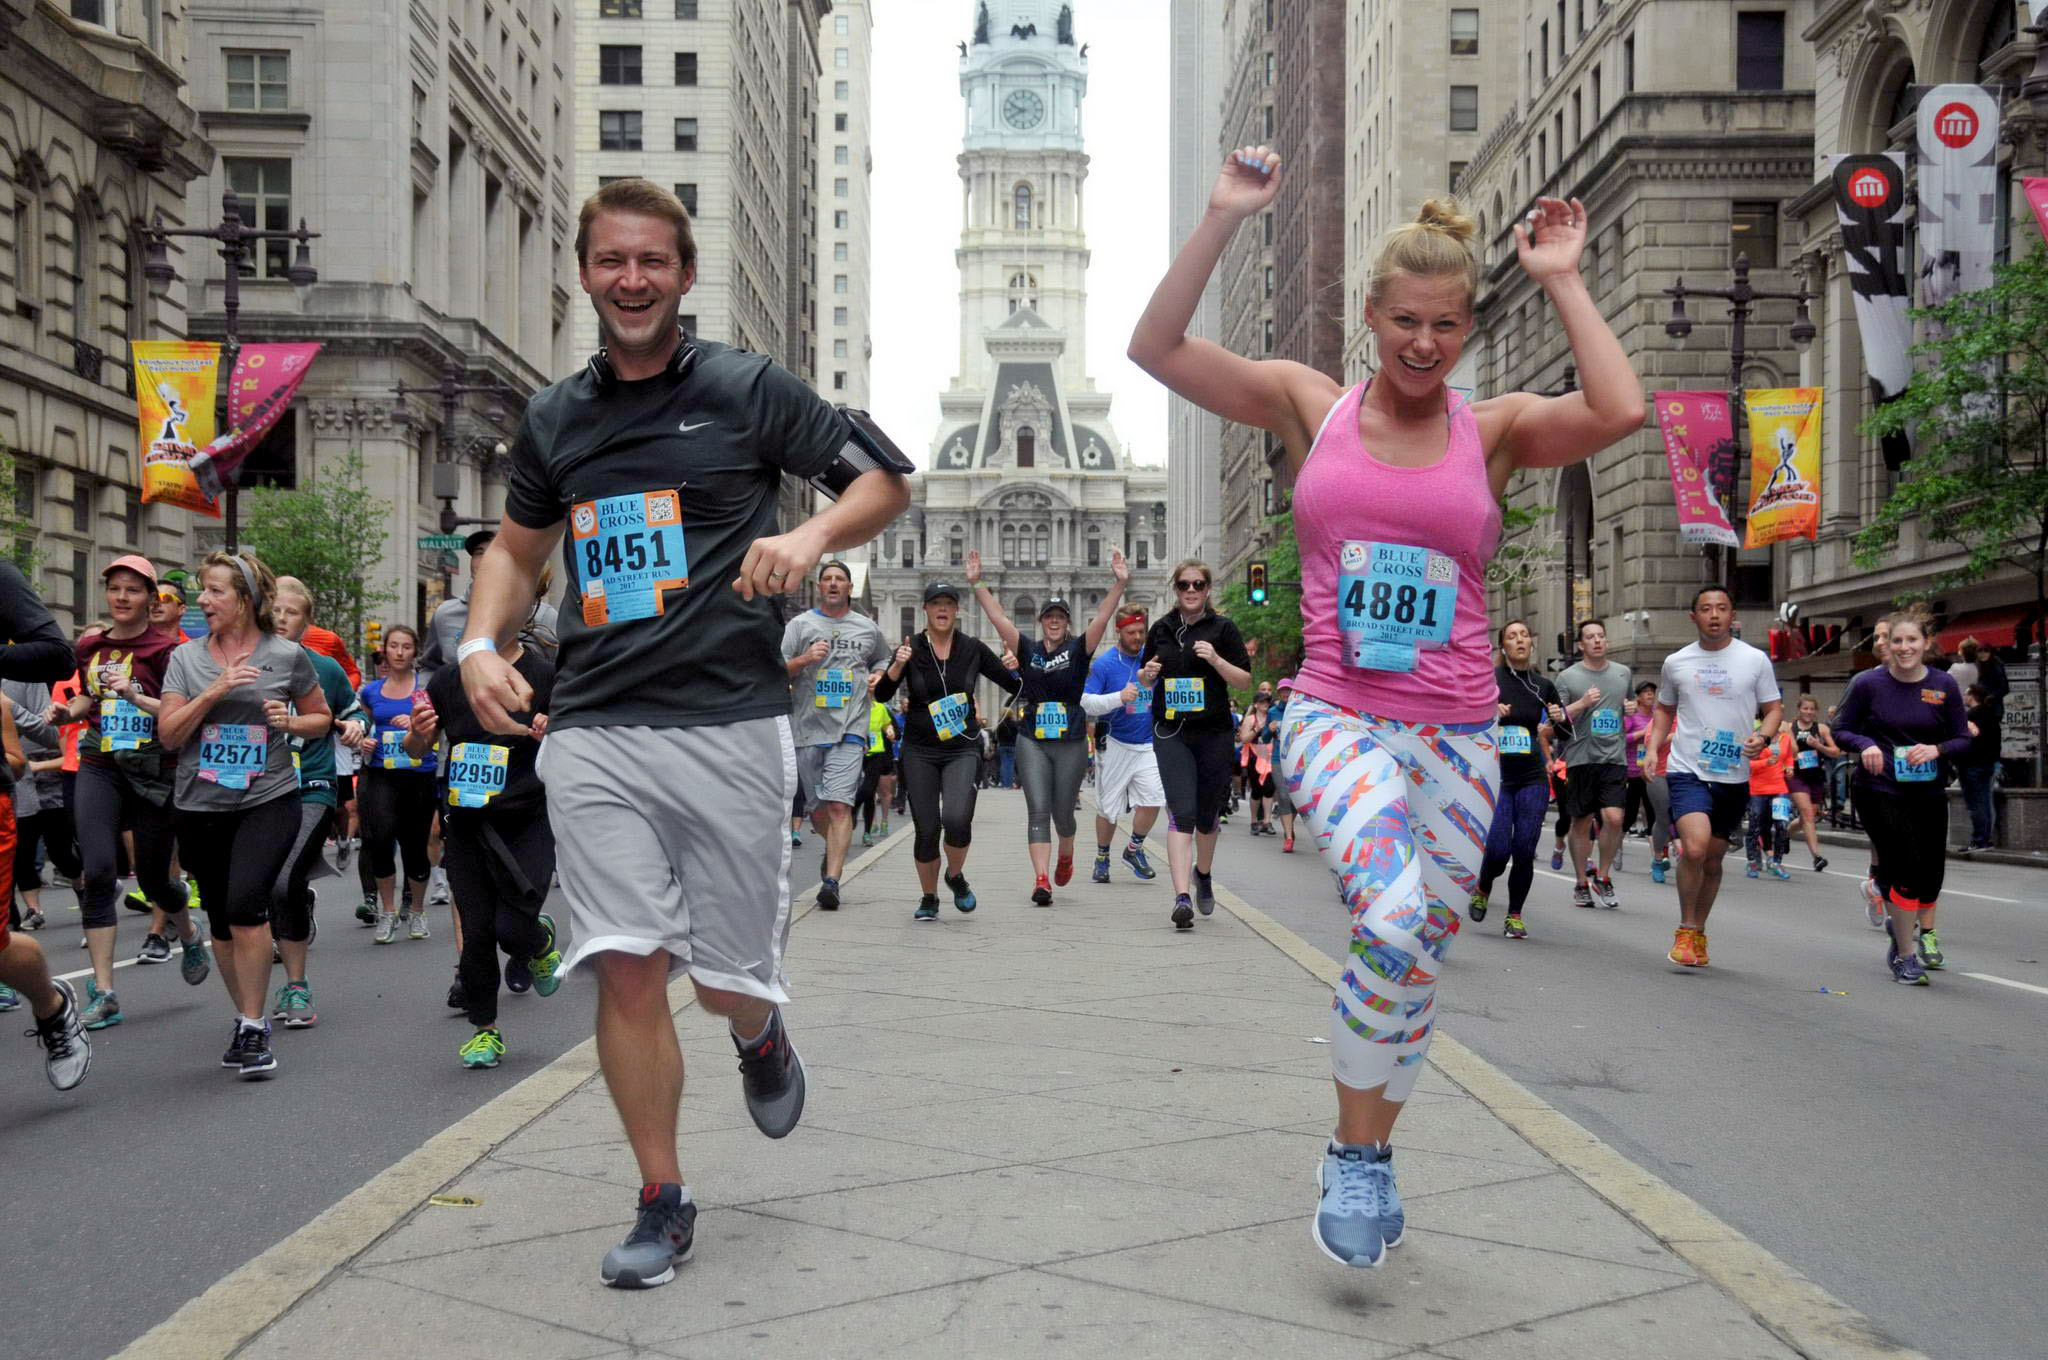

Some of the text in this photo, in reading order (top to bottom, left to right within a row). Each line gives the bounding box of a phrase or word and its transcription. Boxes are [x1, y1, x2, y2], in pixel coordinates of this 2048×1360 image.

[1667, 401, 1706, 515] FIGARO
[600, 500, 639, 516] BLUE
[599, 513, 645, 530] CROSS
[419, 540, 462, 549] WALNUT
[585, 530, 671, 578] 8451
[1379, 549, 1420, 564] BLUE
[617, 571, 650, 583] STREET
[651, 570, 671, 579] RUN
[1372, 562, 1423, 578] CROSS
[619, 582, 636, 591] 2017
[1344, 579, 1437, 628] 4881
[1346, 619, 1434, 637] BROAD STREET RUN
[816, 680, 852, 693] 35065
[1166, 690, 1203, 704] 30661
[933, 702, 969, 727] 31987
[1036, 712, 1067, 725] 31031
[102, 715, 152, 734] 33189
[1592, 719, 1619, 729] 13521
[202, 743, 263, 765] 42571
[1701, 740, 1742, 760] 22554
[450, 761, 505, 786] 32950
